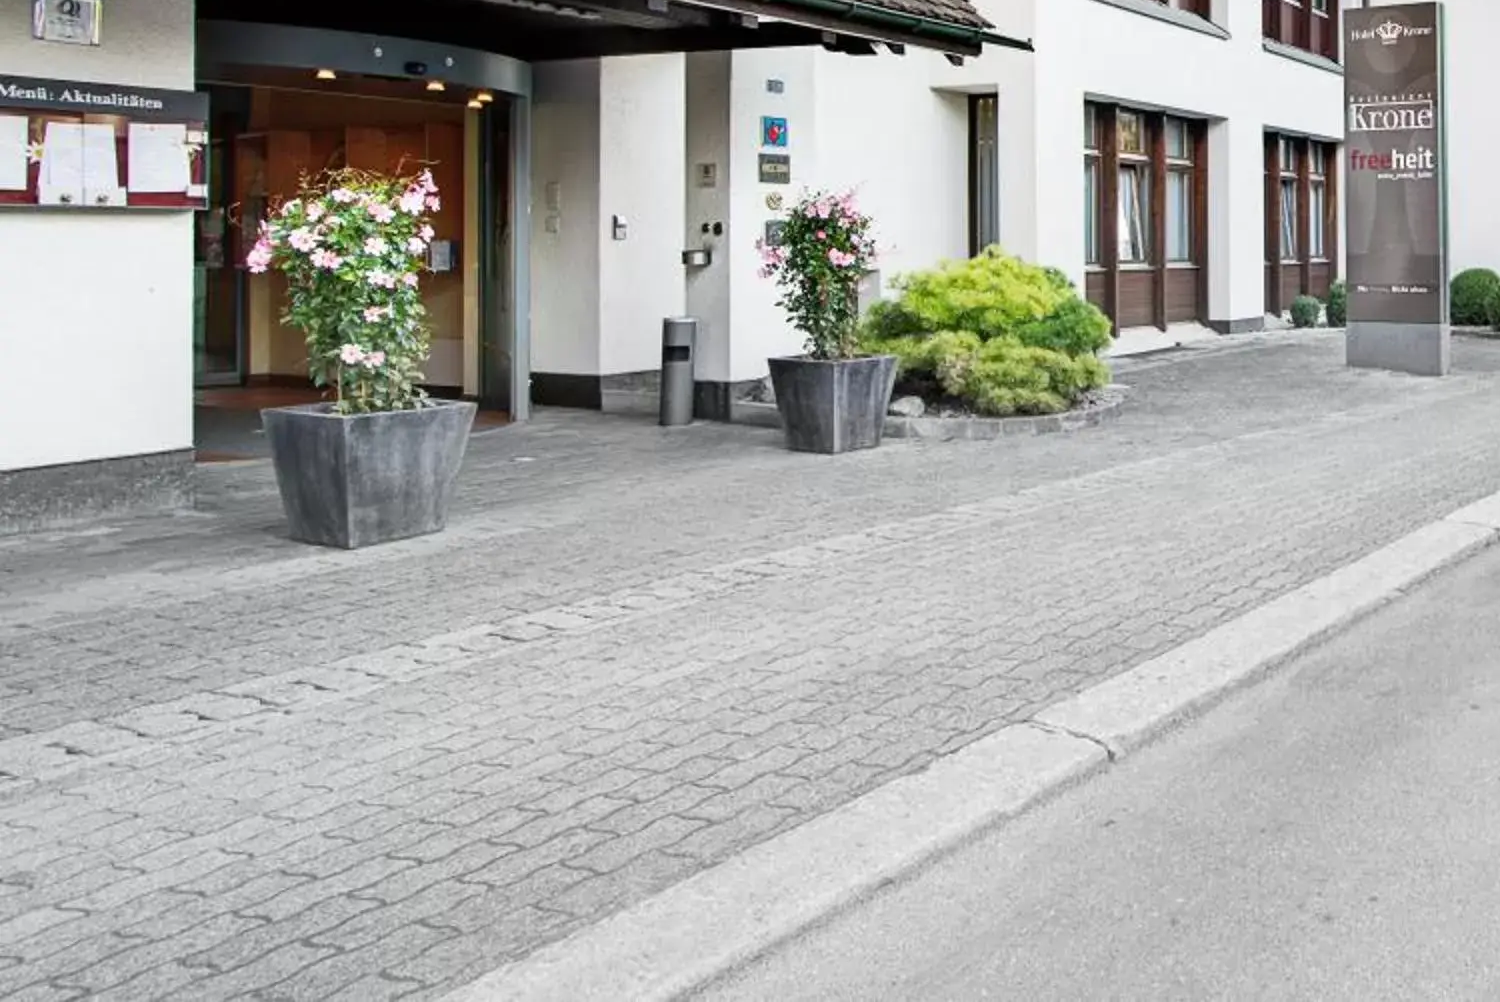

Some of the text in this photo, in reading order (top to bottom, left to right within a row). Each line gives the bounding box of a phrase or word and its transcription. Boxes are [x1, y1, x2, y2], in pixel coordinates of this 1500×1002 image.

[59, 89, 163, 109] Aktualitäten
[1350, 103, 1433, 130] Krone
[1351, 147, 1433, 170] freeheit
